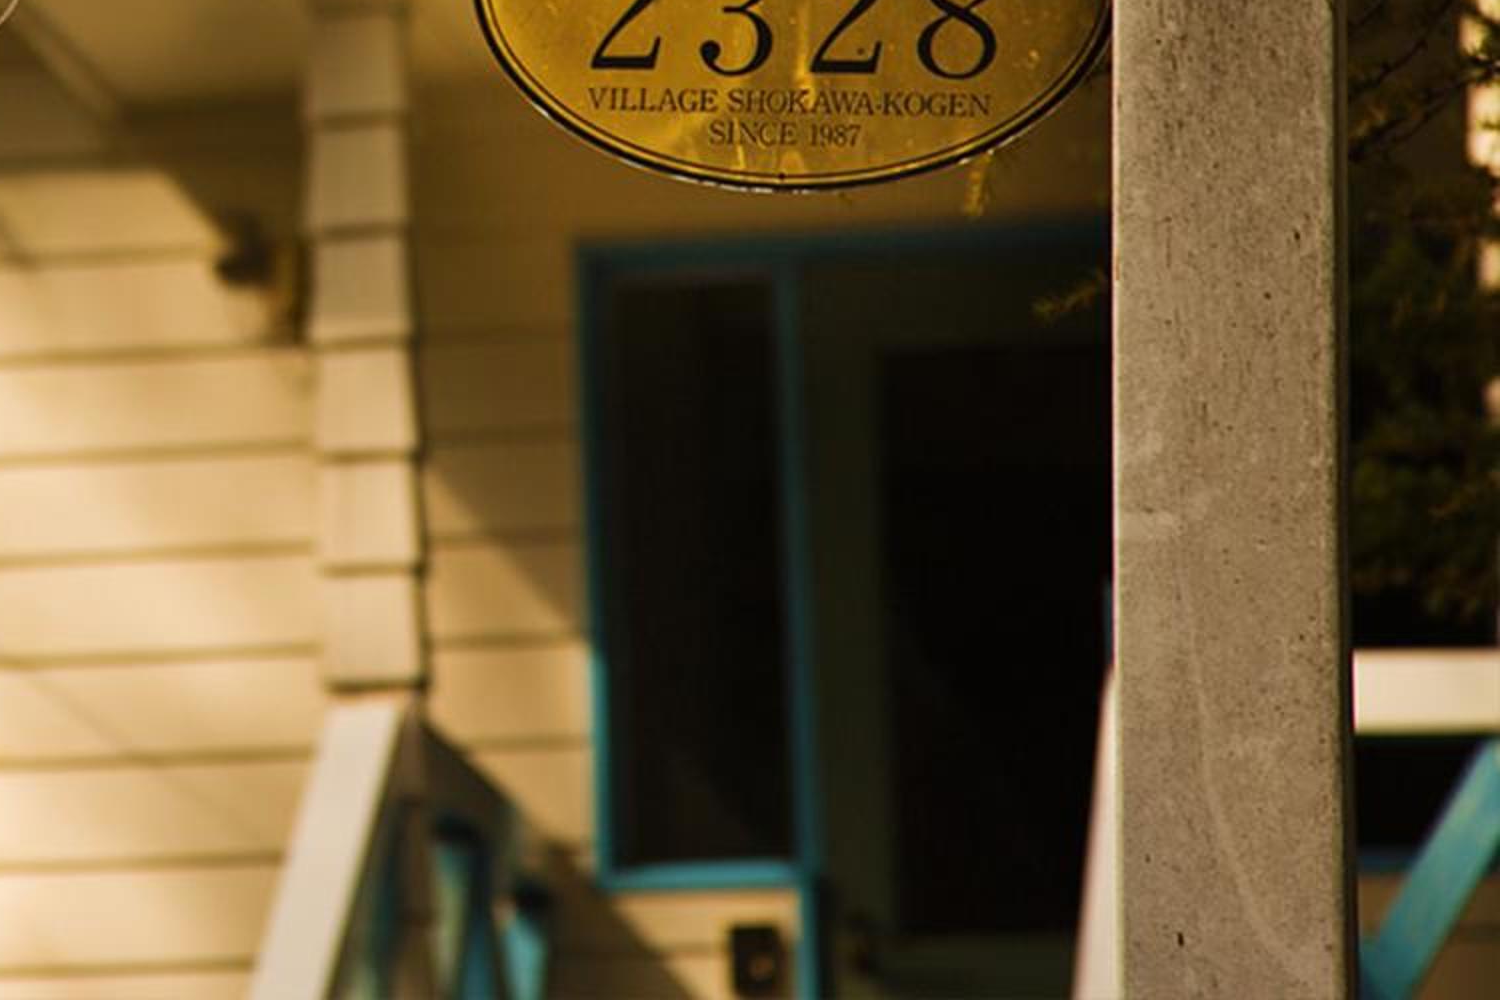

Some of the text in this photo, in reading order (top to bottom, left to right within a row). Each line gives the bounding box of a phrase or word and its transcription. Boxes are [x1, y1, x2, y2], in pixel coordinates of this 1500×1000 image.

[587, 87, 718, 114] VILLAGE
[709, 122, 861, 147] SINCE 1987
